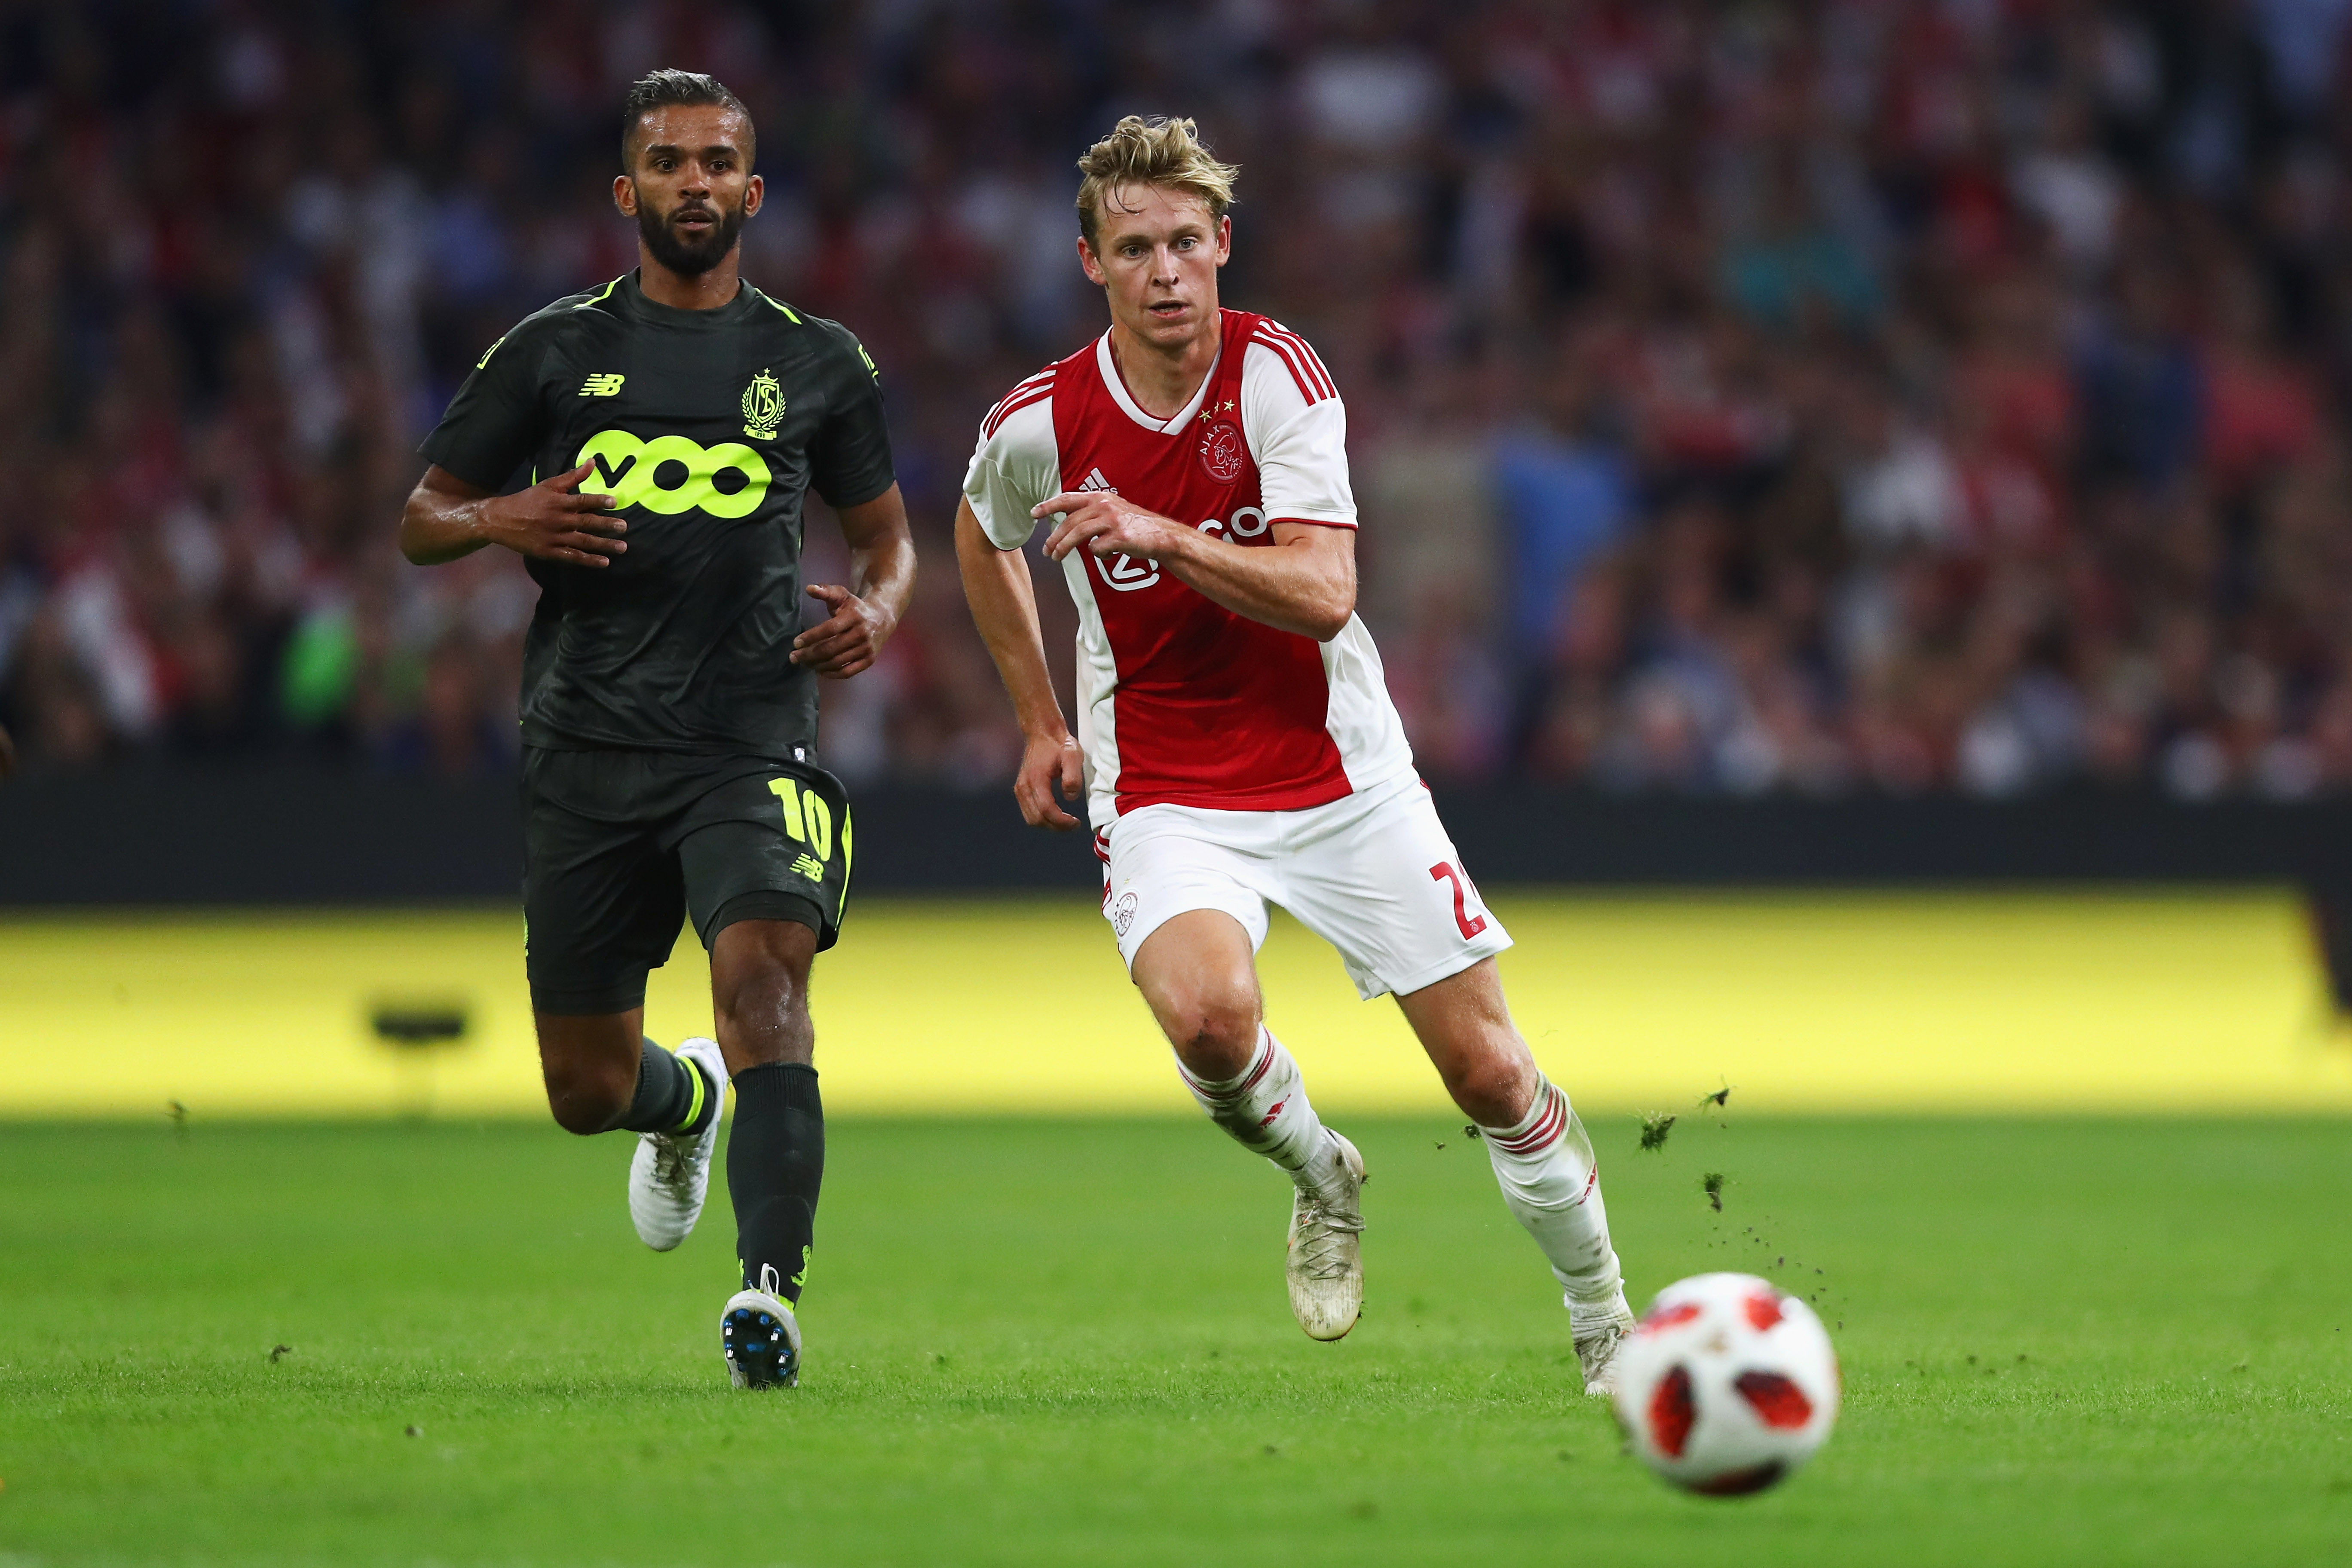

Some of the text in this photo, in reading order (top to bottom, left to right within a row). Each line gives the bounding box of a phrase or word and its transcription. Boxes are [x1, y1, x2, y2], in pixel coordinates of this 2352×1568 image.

[1200, 425, 1220, 455] AJAX
[768, 777, 831, 861] 10
[1429, 854, 1487, 940] 2
